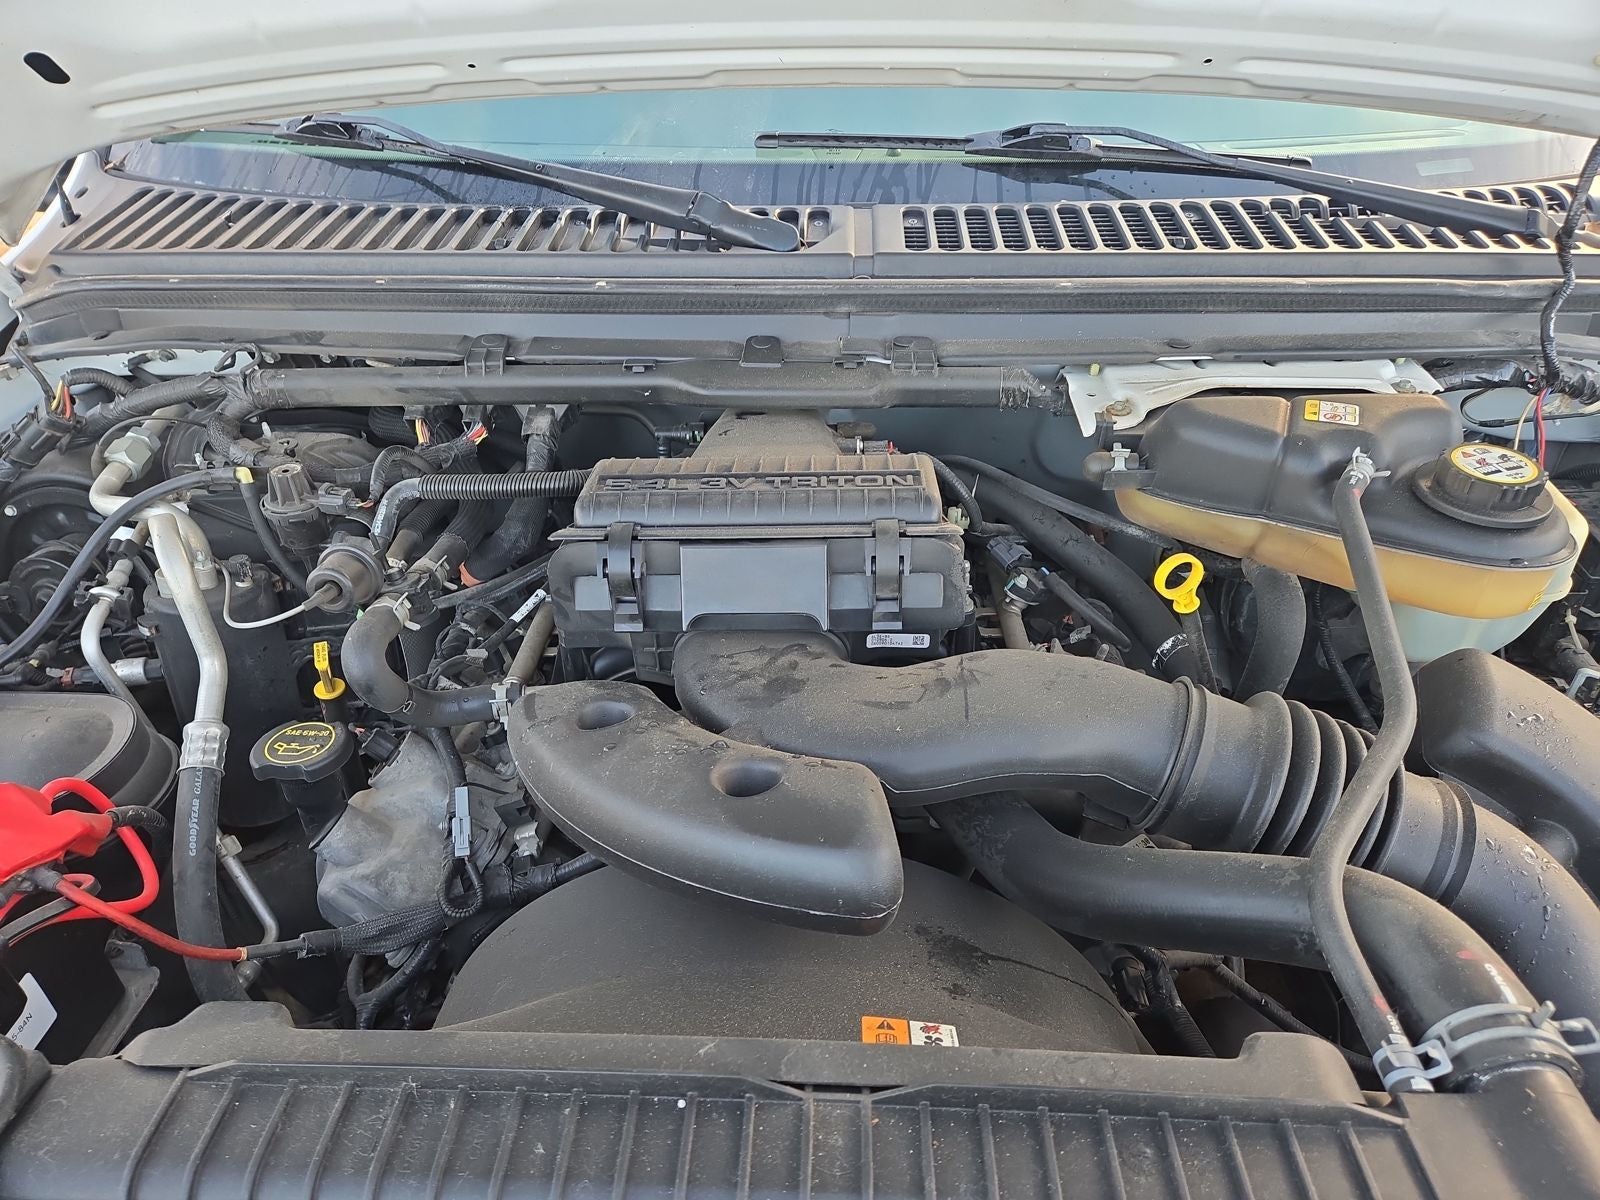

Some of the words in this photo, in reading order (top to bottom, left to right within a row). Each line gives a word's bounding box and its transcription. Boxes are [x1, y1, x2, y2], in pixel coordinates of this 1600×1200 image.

[700, 477, 756, 490] 3V
[766, 475, 914, 488] TRITON
[189, 798, 200, 857] GOODYEAR
